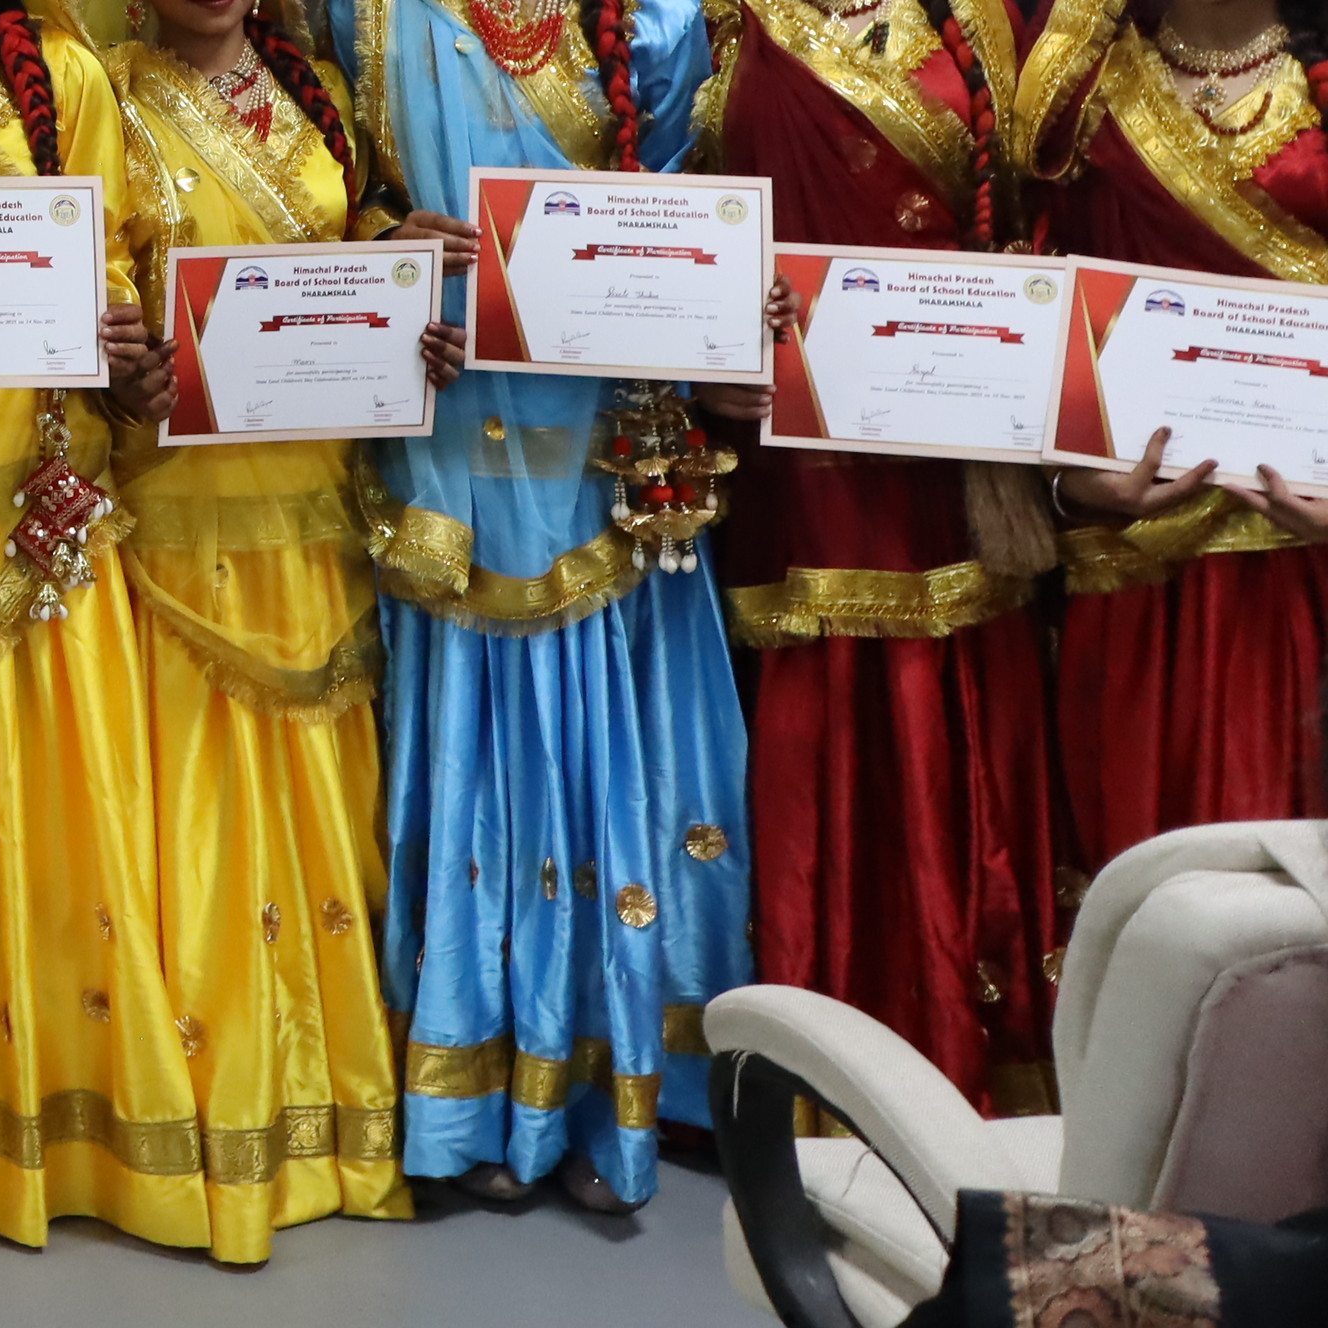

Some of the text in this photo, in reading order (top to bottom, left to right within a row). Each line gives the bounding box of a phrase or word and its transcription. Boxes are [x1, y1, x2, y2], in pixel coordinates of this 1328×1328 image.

[607, 194, 688, 206] Himachal Pradesh
[587, 206, 709, 219] Board of School Education
[617, 220, 678, 229] DHARAMSHALA
[293, 264, 367, 274] Himachal Pradesh
[274, 275, 385, 287] Board of School Education
[908, 273, 994, 283] Himachal Pradesh
[301, 289, 356, 297] DHARAMSHALA
[932, 286, 964, 294] School
[967, 288, 1016, 297] Education
[919, 298, 983, 307] DHARAMSHALA
[1216, 298, 1310, 315] Himachal Pradesh
[1192, 308, 1224, 318] Board
[1227, 312, 1239, 320] of
[1241, 314, 1276, 324] School
